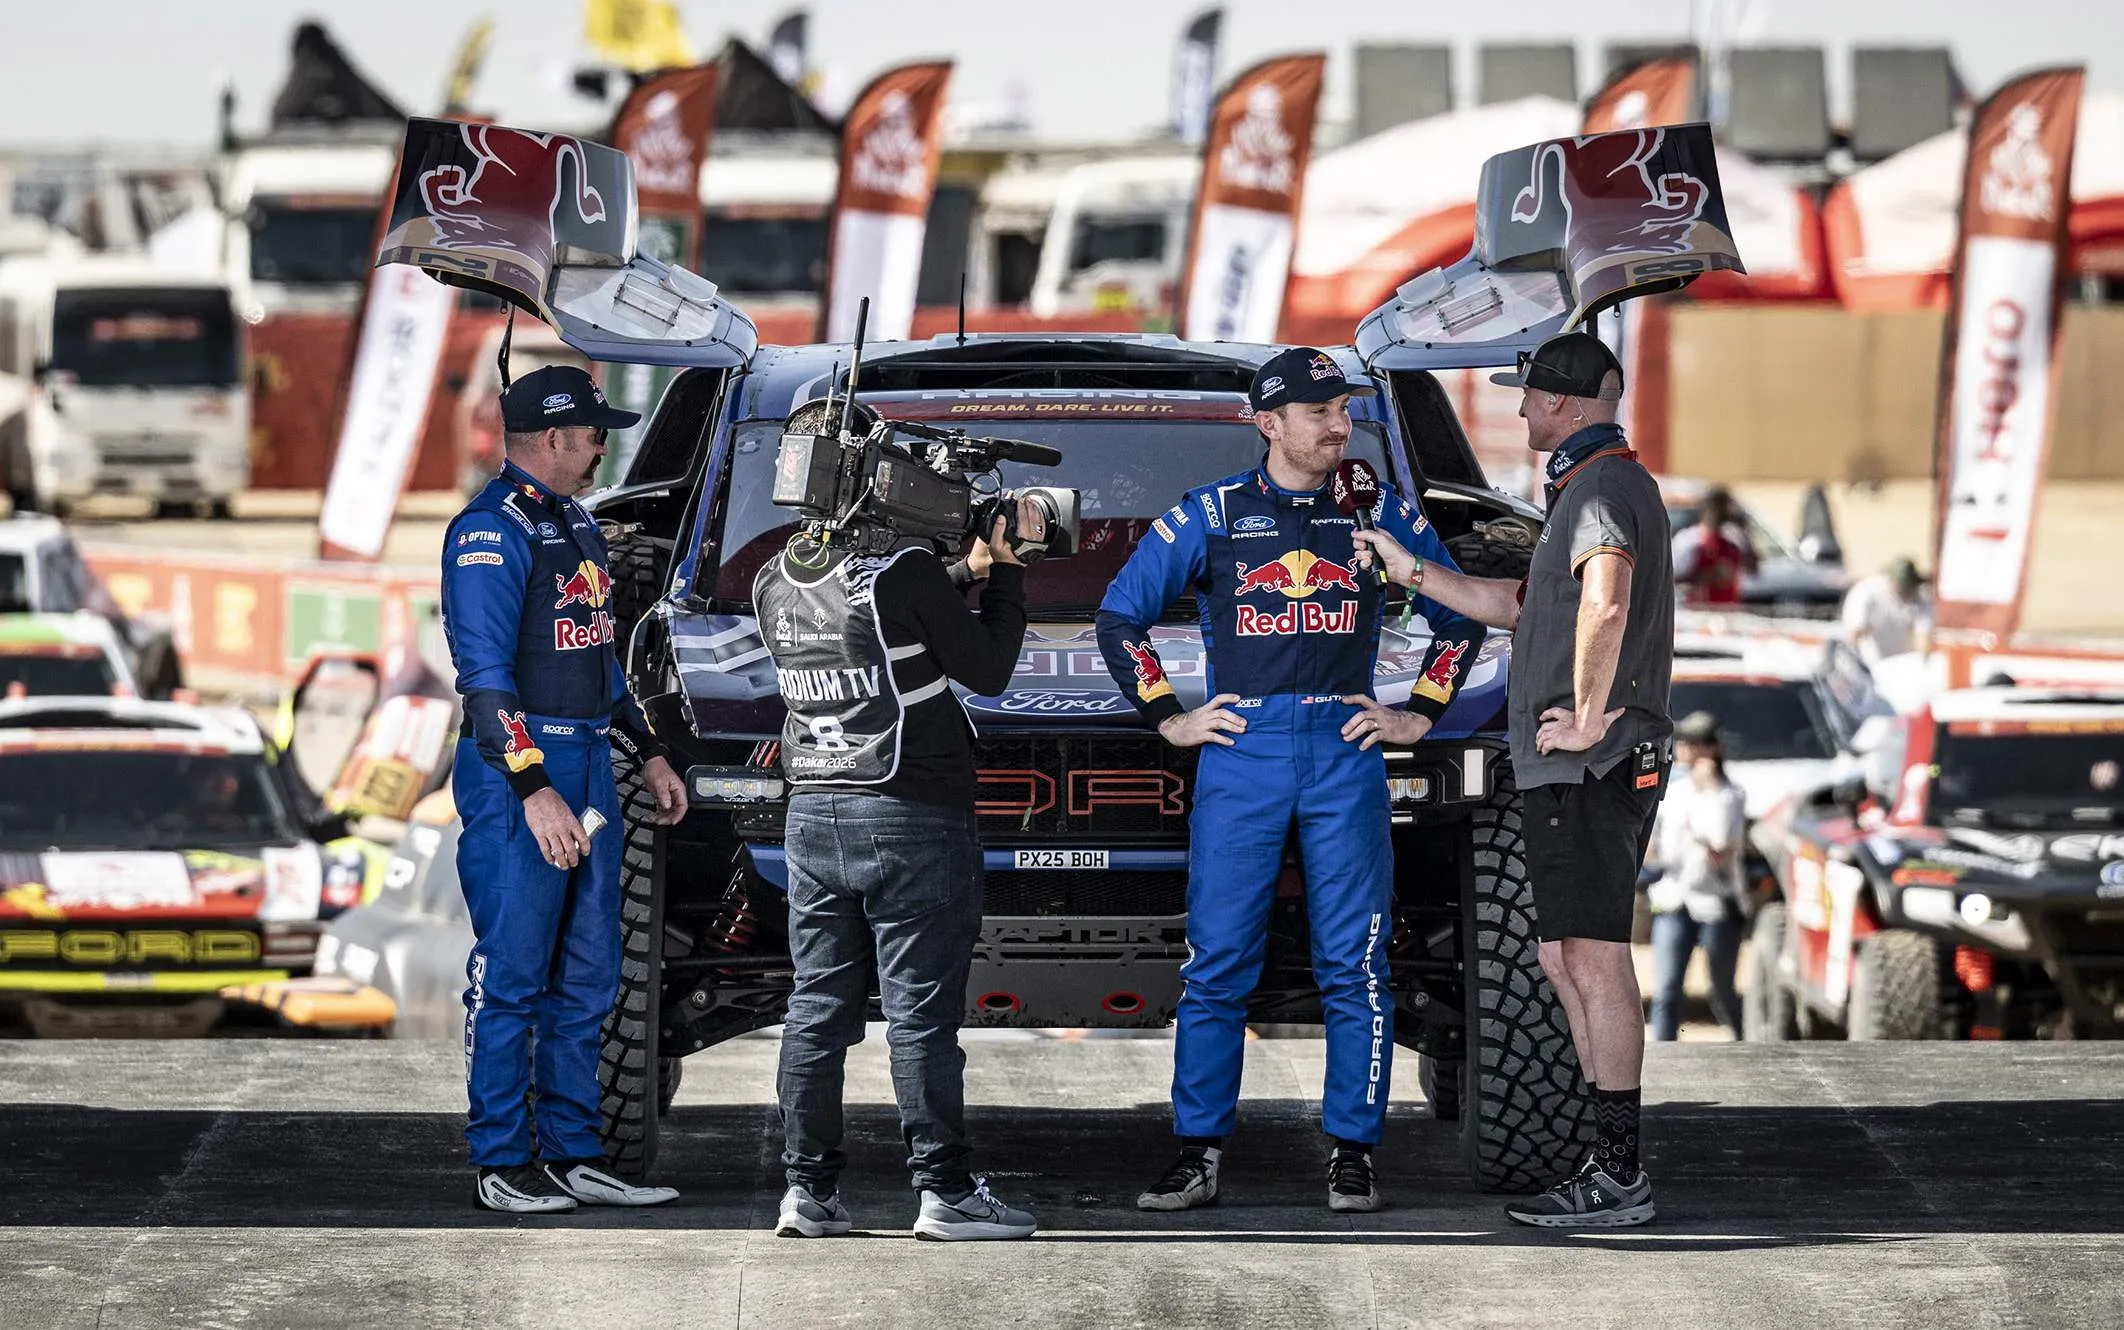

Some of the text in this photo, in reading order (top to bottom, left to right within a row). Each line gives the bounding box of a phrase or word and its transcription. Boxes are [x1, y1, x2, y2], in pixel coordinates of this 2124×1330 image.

[543, 403, 575, 415] RACING
[951, 403, 1174, 413] DREAM. DARE. LIVE IT.
[1352, 480, 1377, 491] DAKAR
[1200, 493, 1221, 529] sparco
[500, 504, 536, 536] sparco
[468, 531, 502, 543] OPTIMA
[1231, 531, 1279, 540] RACING
[466, 554, 501, 564] Castrol
[1236, 600, 1358, 636] Red Bull
[555, 611, 601, 650] Red
[842, 665, 880, 699] TV
[1001, 690, 1120, 711] Ford
[1237, 698, 1262, 707] parco
[542, 724, 575, 735] sparco
[809, 716, 850, 752] 8
[609, 727, 638, 754] sparco
[792, 756, 857, 769] #Dakar2026
[1020, 852, 1104, 867] PX25 BOH
[1366, 1015, 1384, 1105] FORD
